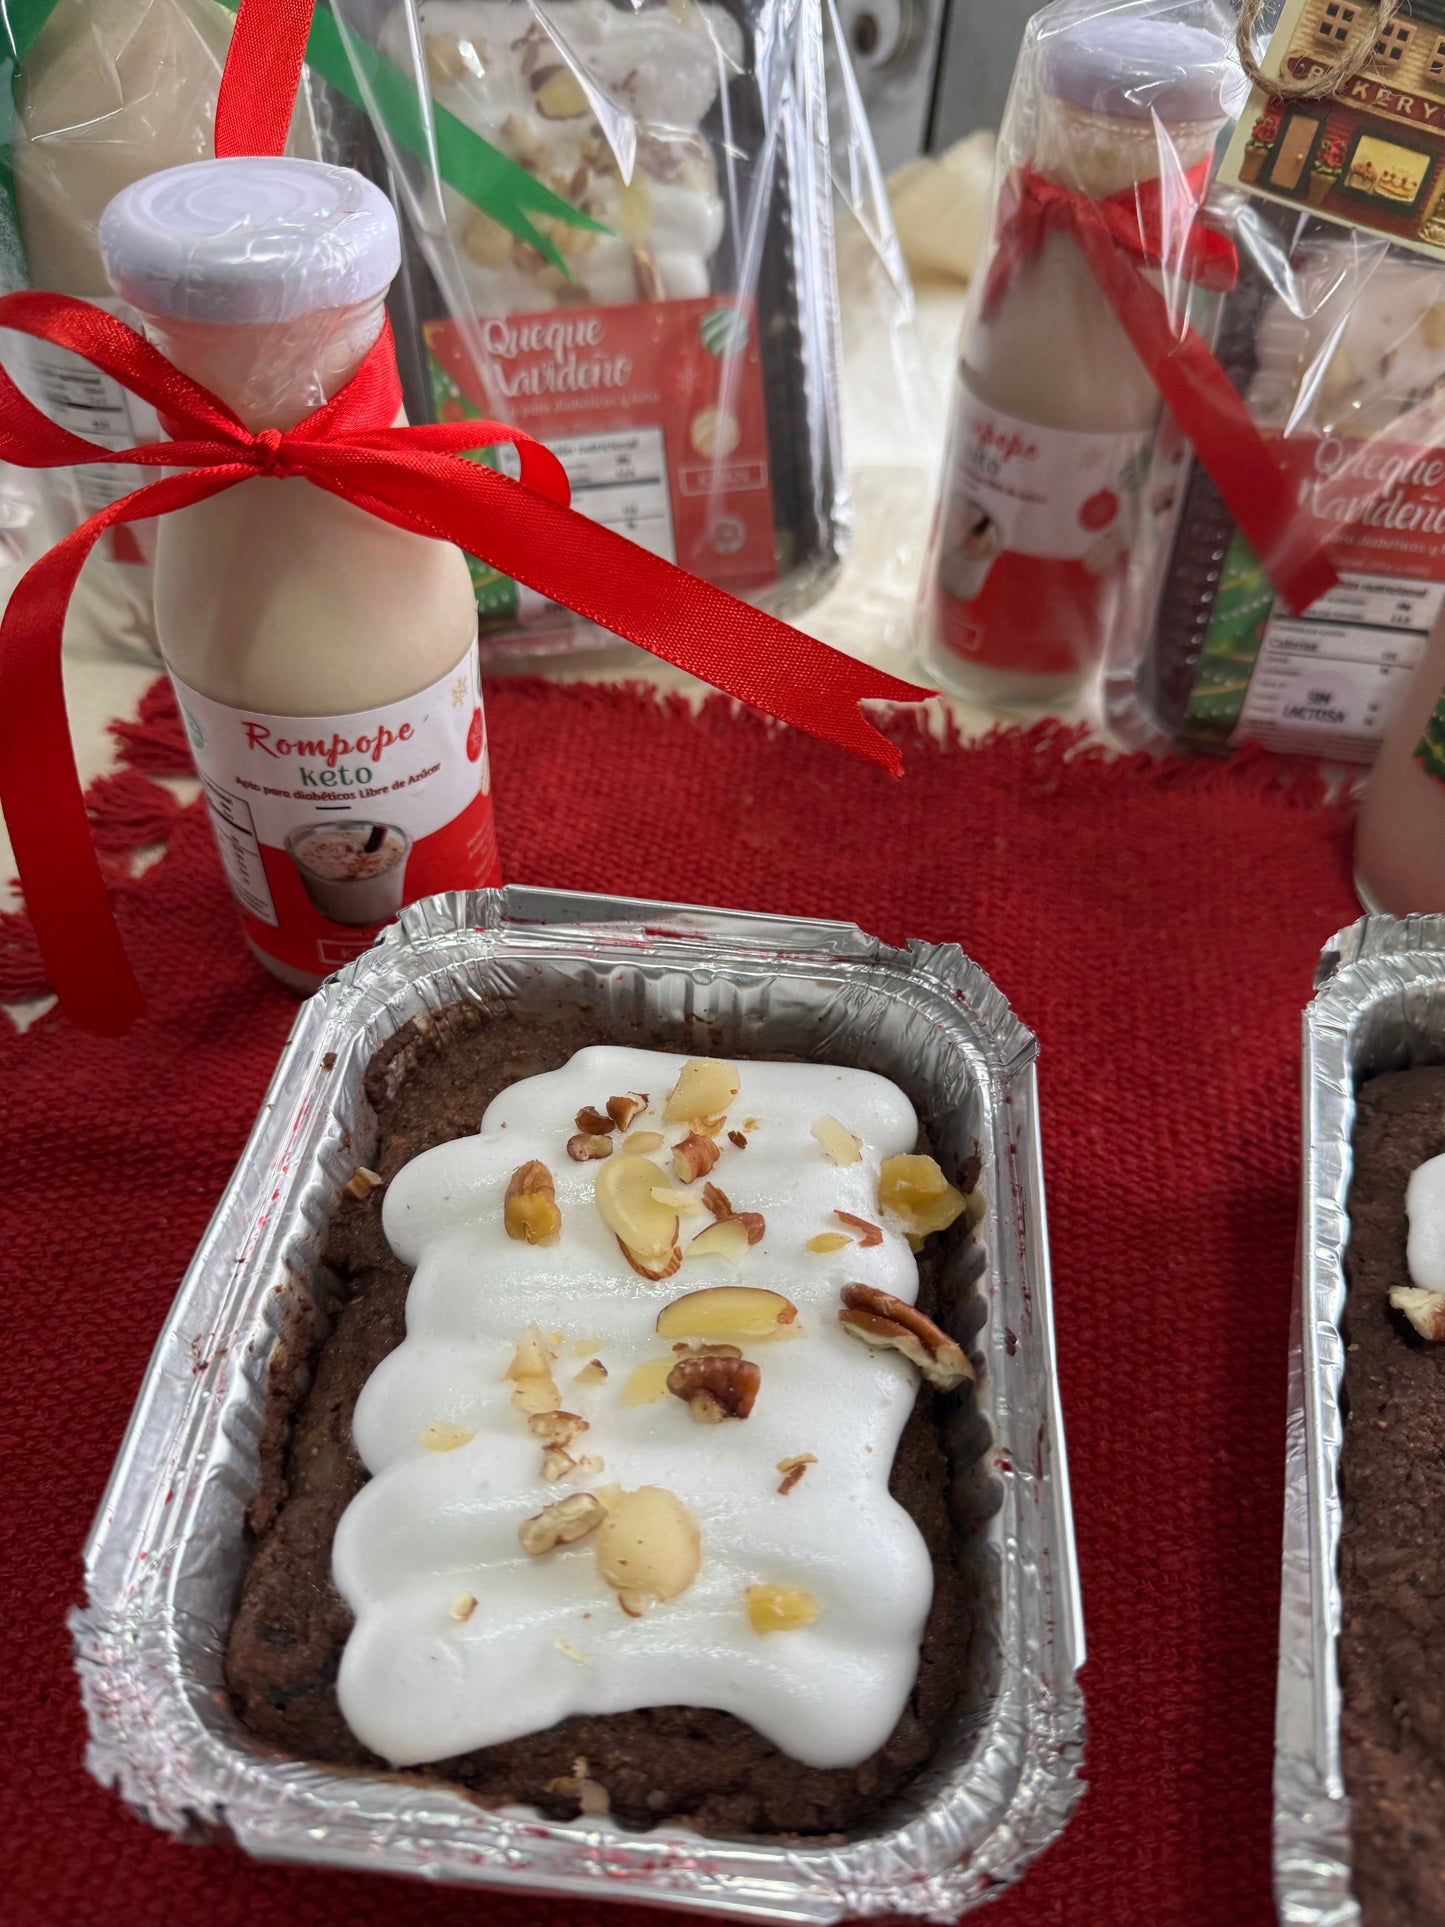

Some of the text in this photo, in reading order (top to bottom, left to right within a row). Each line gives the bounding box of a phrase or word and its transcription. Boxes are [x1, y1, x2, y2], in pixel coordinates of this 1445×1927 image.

[1307, 64, 1439, 119] BKERY
[484, 318, 605, 364] Queque
[241, 721, 415, 768] Rompope
[263, 784, 291, 798] para
[293, 788, 356, 801] diabéticos
[359, 785, 389, 799] Libre
[392, 780, 406, 792] de
[407, 762, 442, 786] Azúcar
[300, 765, 373, 787] keto
